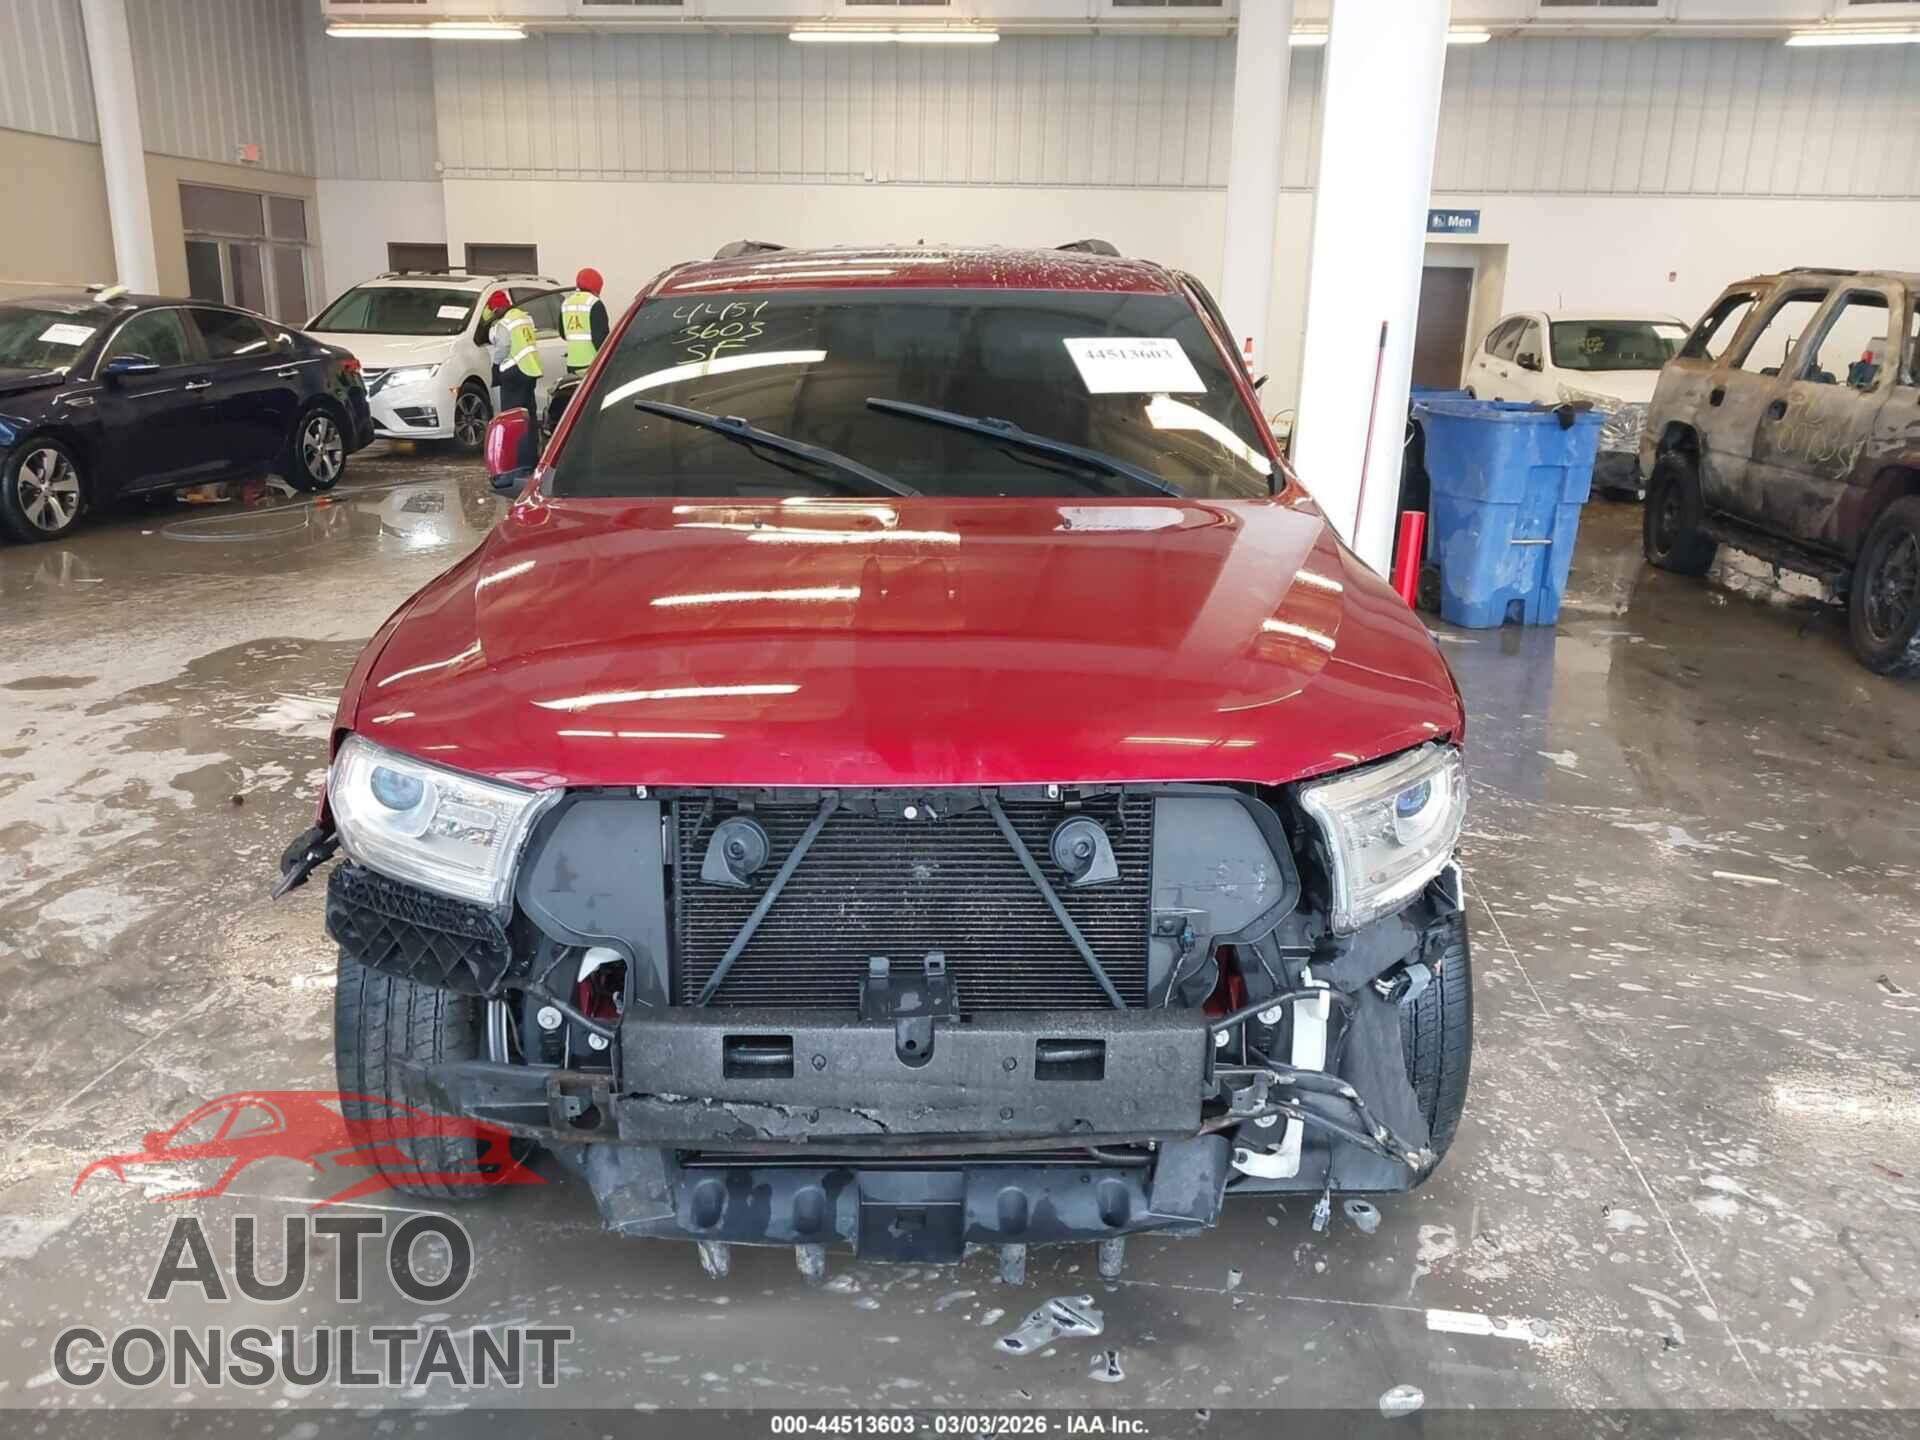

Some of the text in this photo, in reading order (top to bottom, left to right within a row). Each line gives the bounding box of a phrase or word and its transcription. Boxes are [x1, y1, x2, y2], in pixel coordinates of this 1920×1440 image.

[1448, 215, 1472, 227] Men
[673, 301, 768, 324] 4451
[672, 322, 766, 344] 3603
